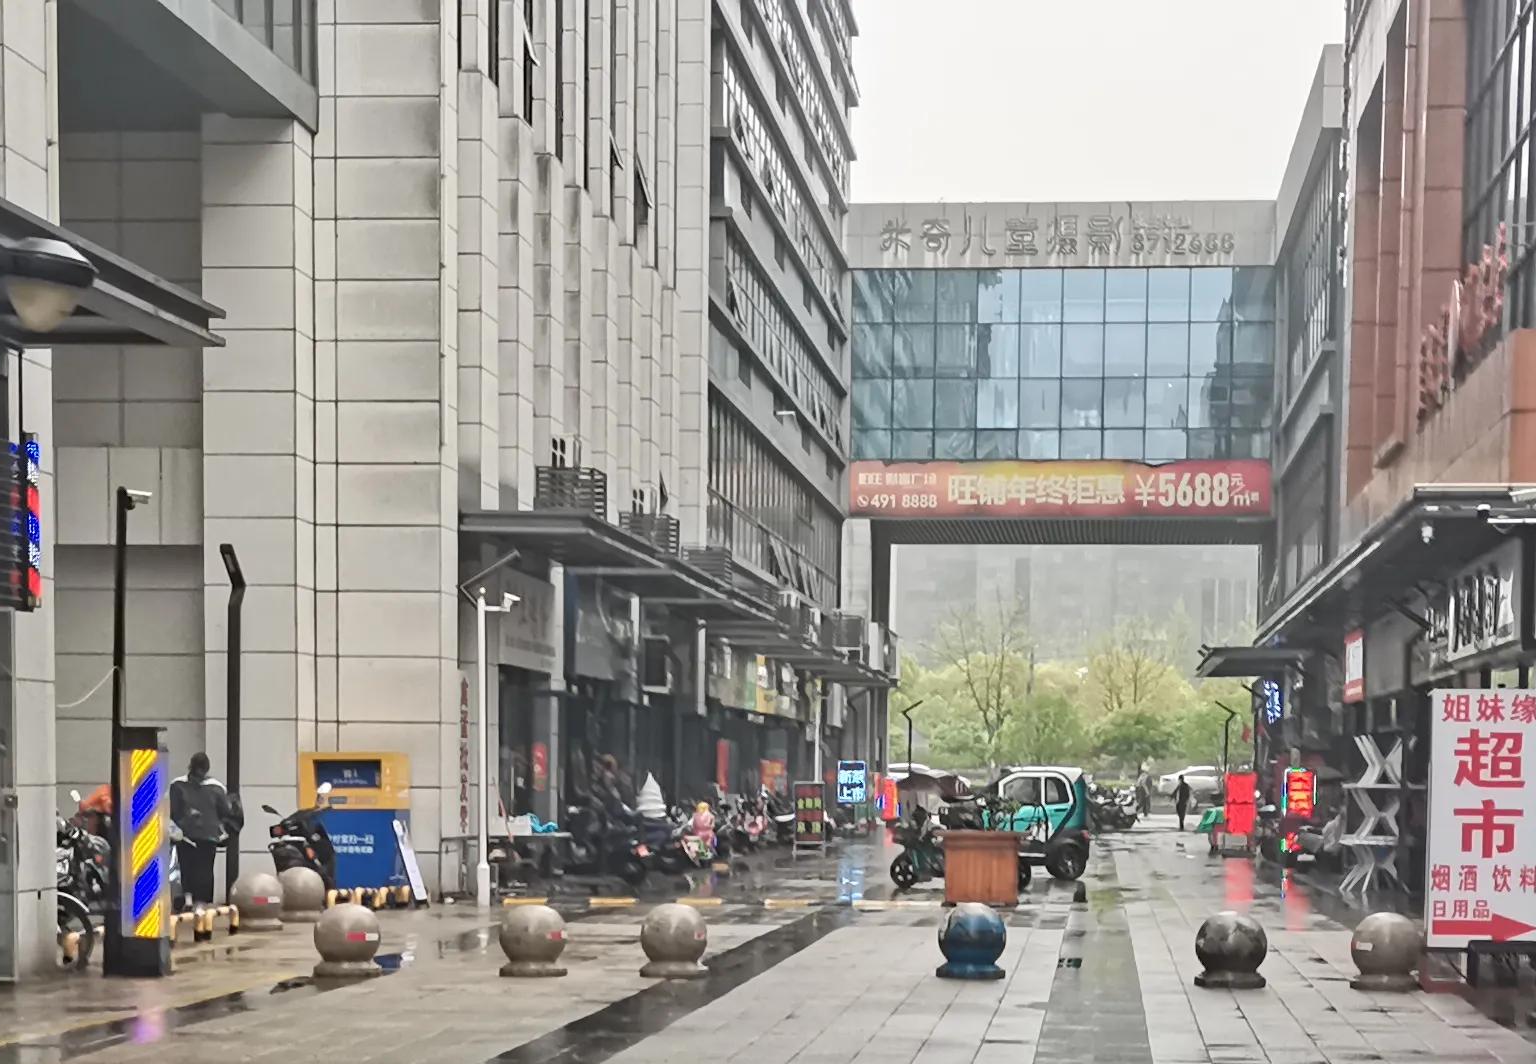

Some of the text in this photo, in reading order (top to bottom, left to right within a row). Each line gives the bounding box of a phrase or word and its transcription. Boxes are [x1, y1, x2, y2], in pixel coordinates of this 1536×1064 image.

[870, 493, 938, 509] 491 8888
[1453, 728, 1526, 859] 超市
[1430, 863, 1478, 894] 烟酒
[1432, 899, 1491, 919] 日用品
